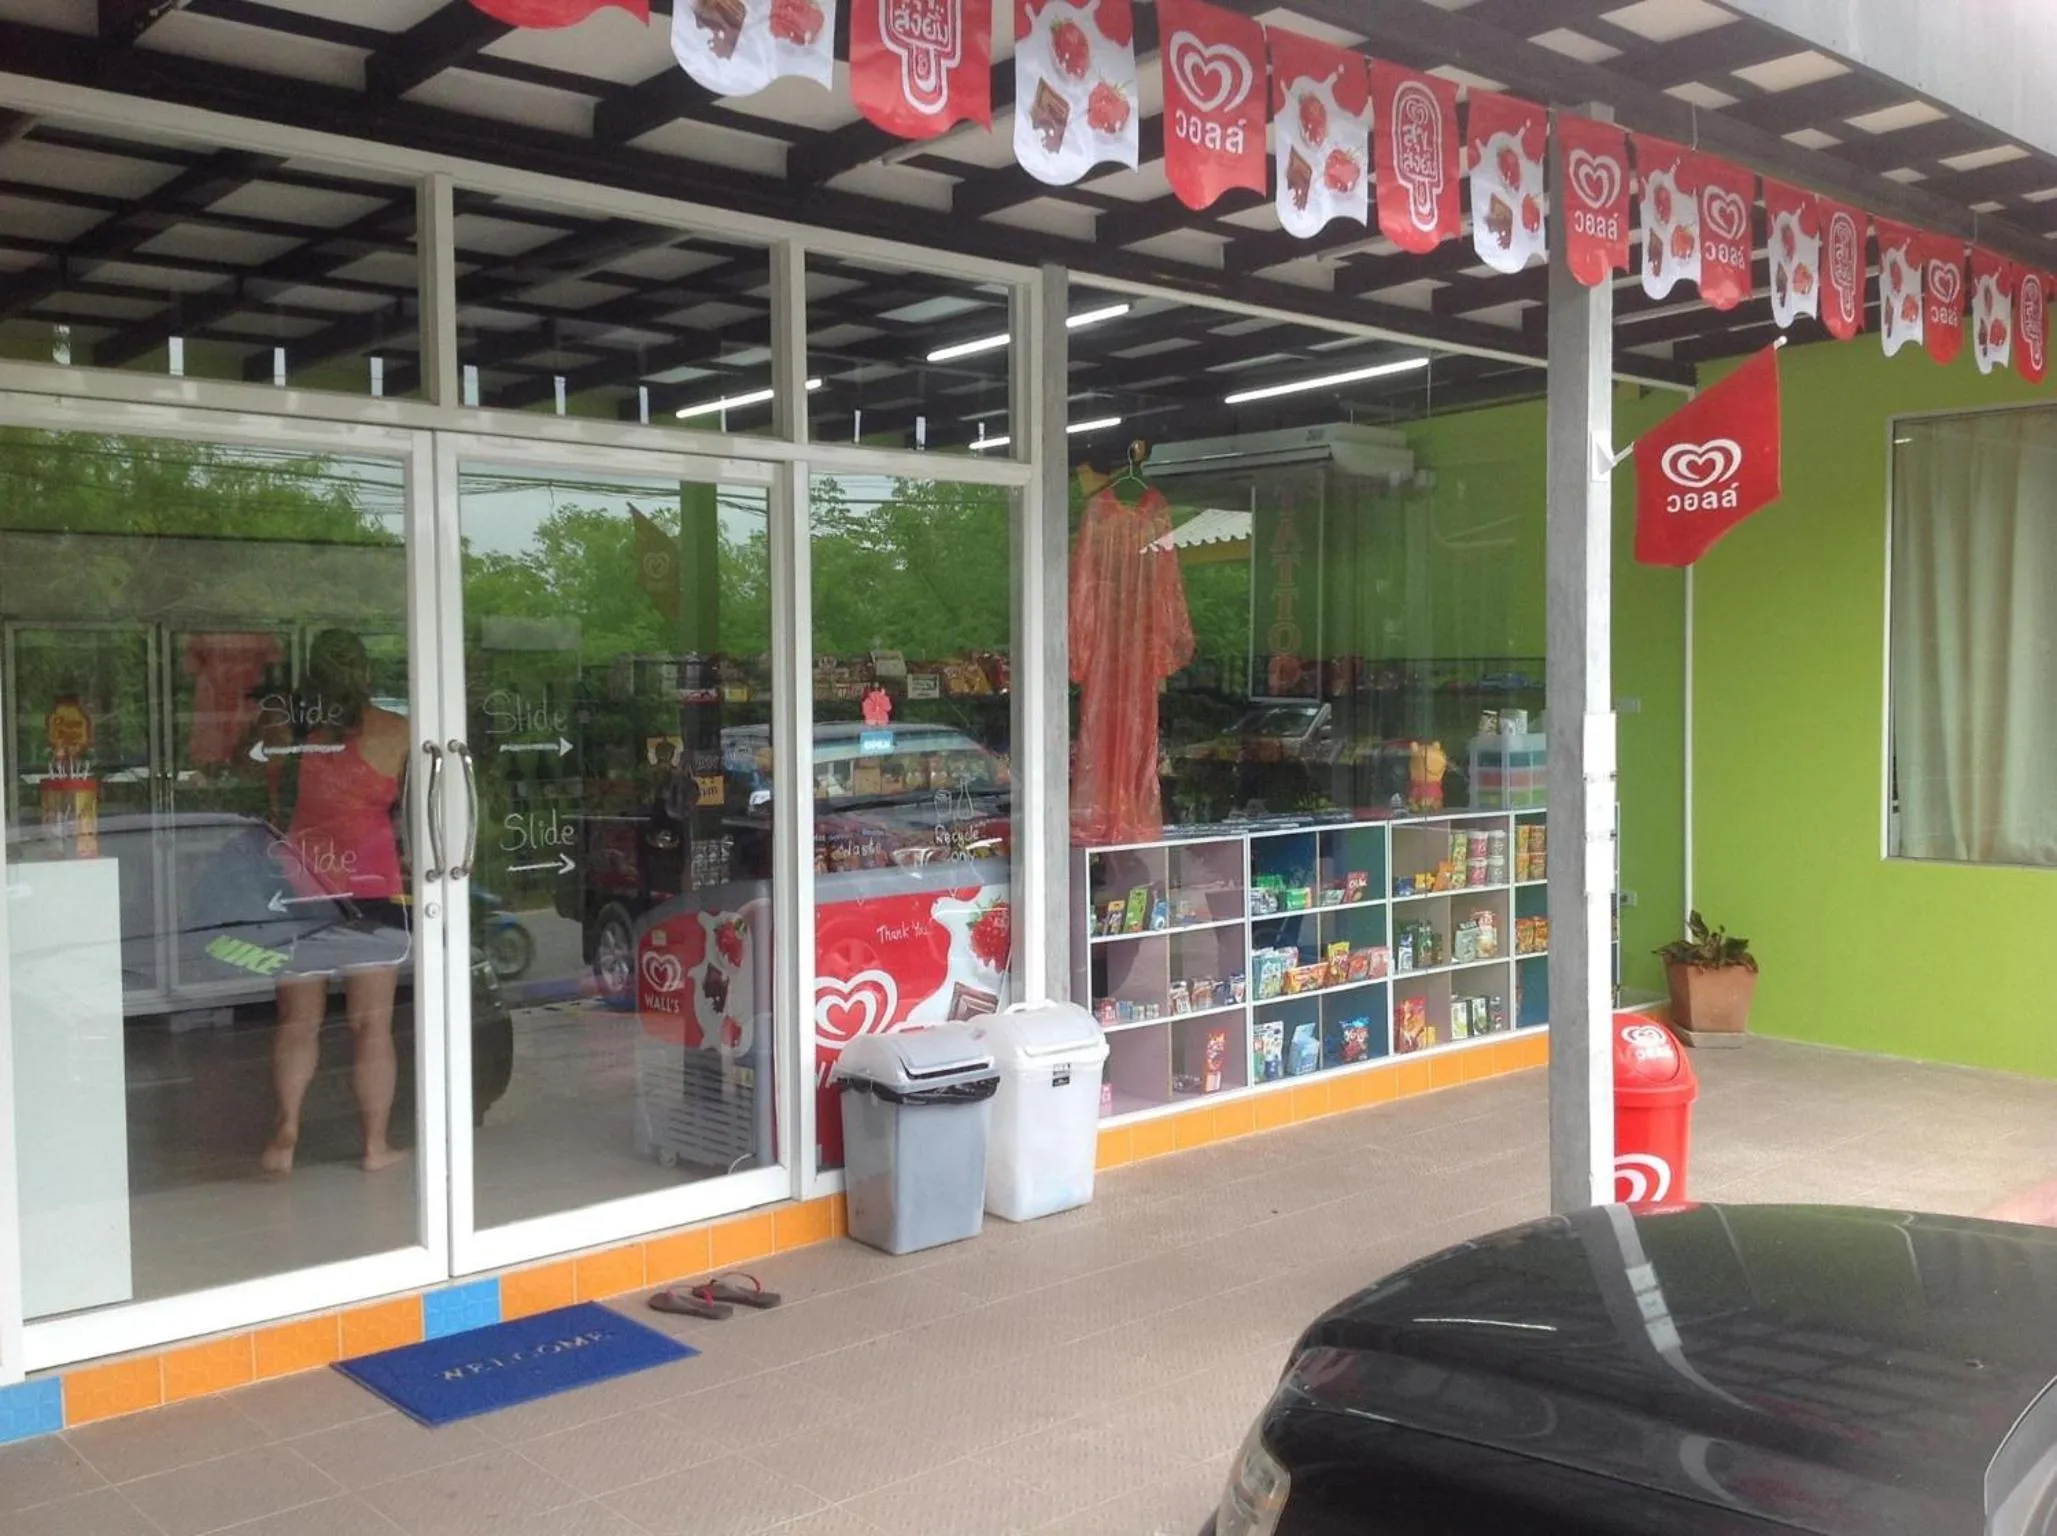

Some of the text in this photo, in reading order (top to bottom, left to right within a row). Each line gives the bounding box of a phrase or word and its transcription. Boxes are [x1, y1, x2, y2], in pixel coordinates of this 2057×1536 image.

[1175, 108, 1247, 155] วอลล์
[1574, 210, 1619, 241] วอลล์
[1705, 241, 1746, 270] วอลล์
[1666, 481, 1740, 513] วอลล์
[258, 693, 344, 729] Slide
[482, 686, 568, 734] Slide
[500, 808, 576, 851] Slide
[267, 837, 358, 879] Slide
[876, 920, 910, 944] Thank
